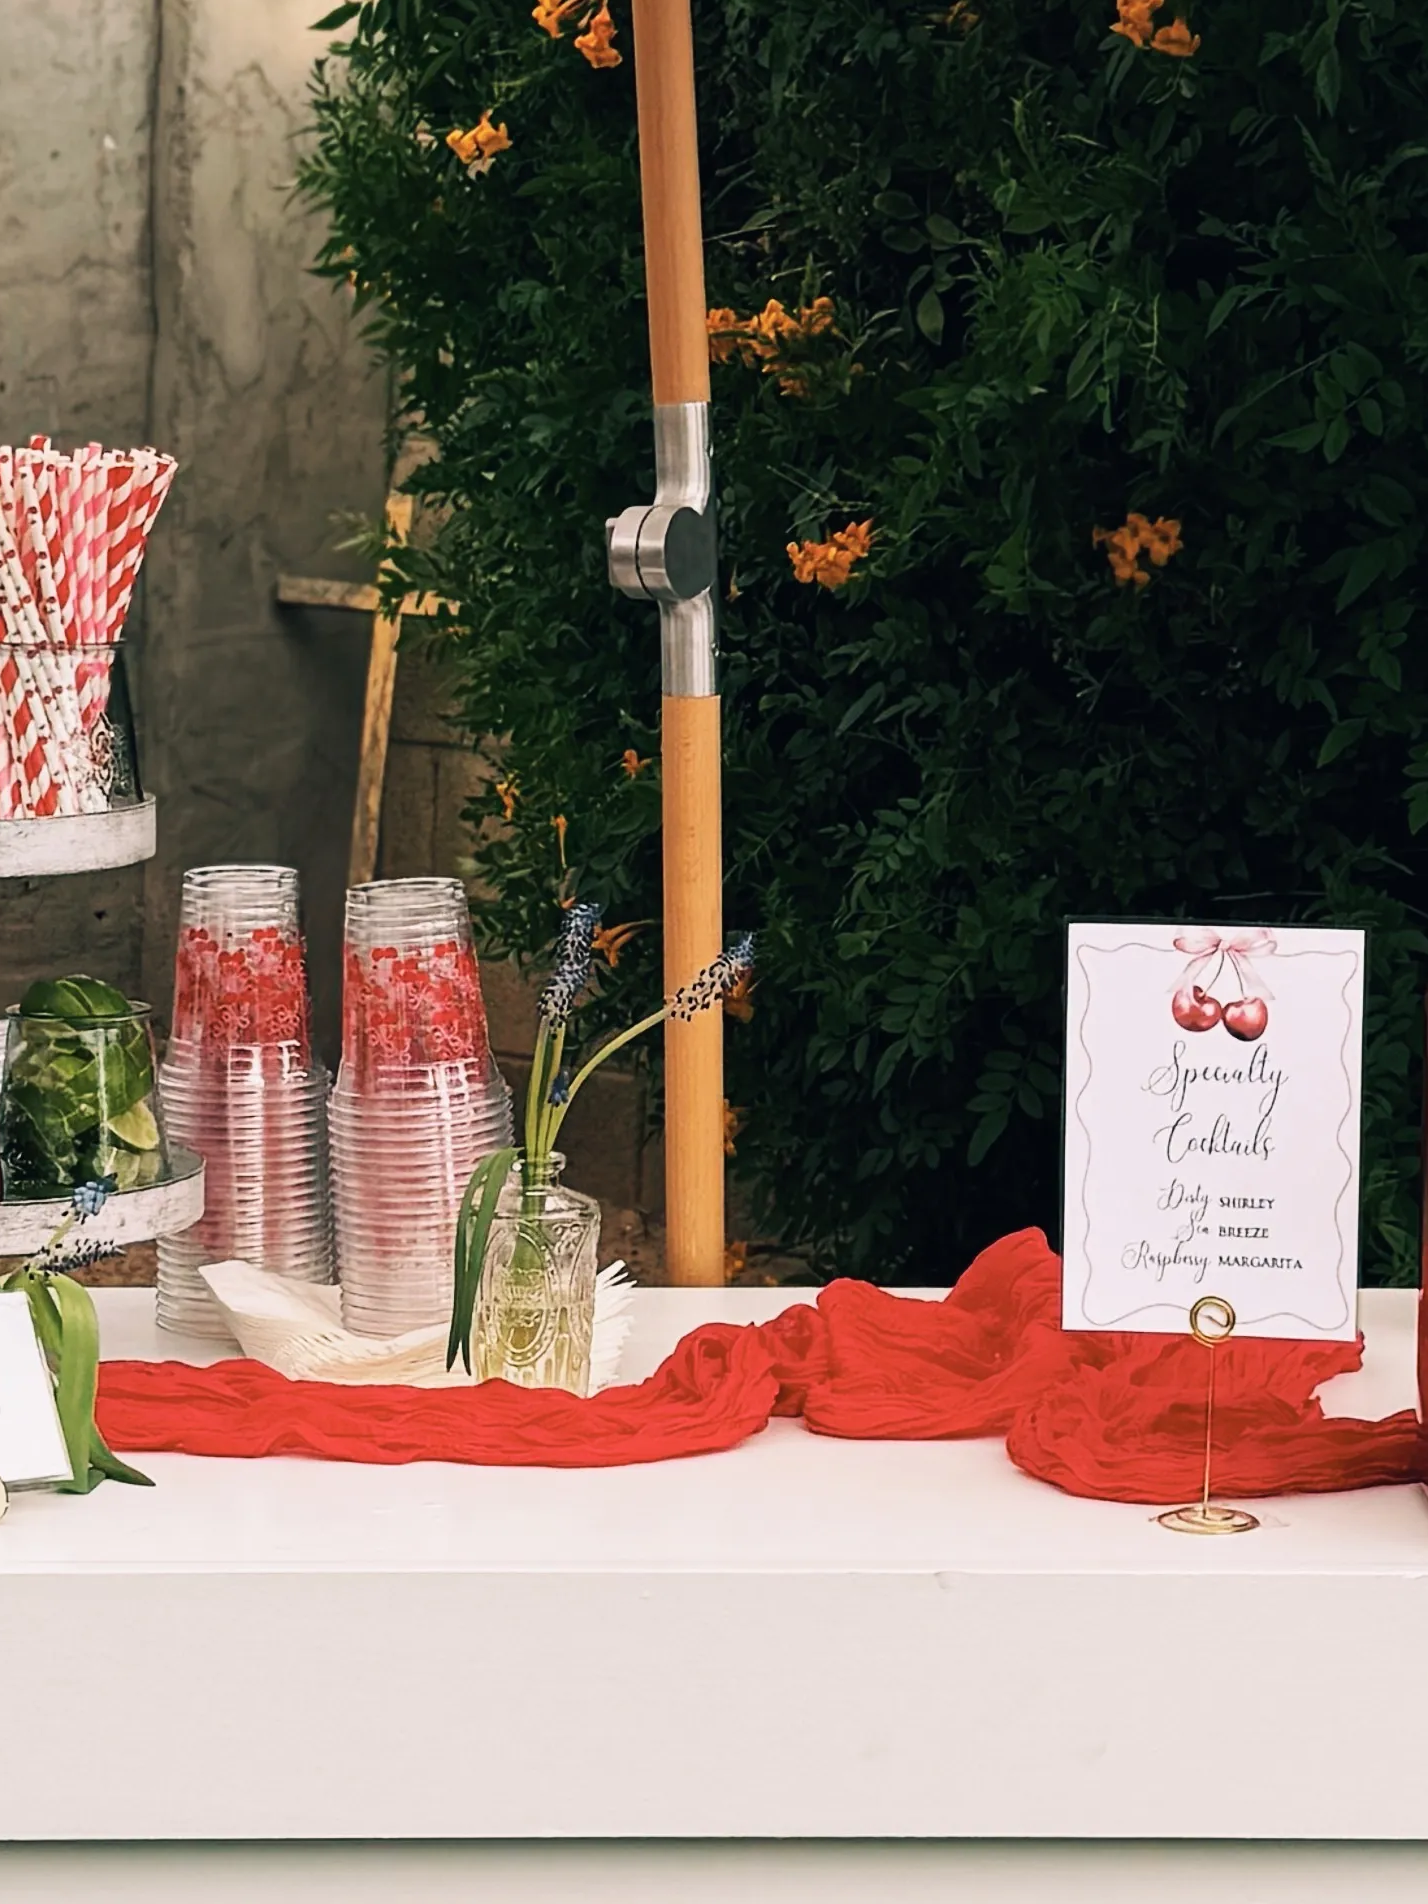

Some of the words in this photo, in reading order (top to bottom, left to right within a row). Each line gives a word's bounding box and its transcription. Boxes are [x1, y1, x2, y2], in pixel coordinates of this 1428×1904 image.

[1141, 1039, 1290, 1117] Specialty
[1153, 1112, 1276, 1164] Cocktails
[1157, 1178, 1210, 1222] Dirty
[1218, 1196, 1276, 1211] SHIRLEY
[1170, 1210, 1209, 1242] Sea
[1218, 1225, 1270, 1240] BREEZE
[1121, 1240, 1210, 1284] Raspberry
[1217, 1254, 1304, 1270] MARGARITA
